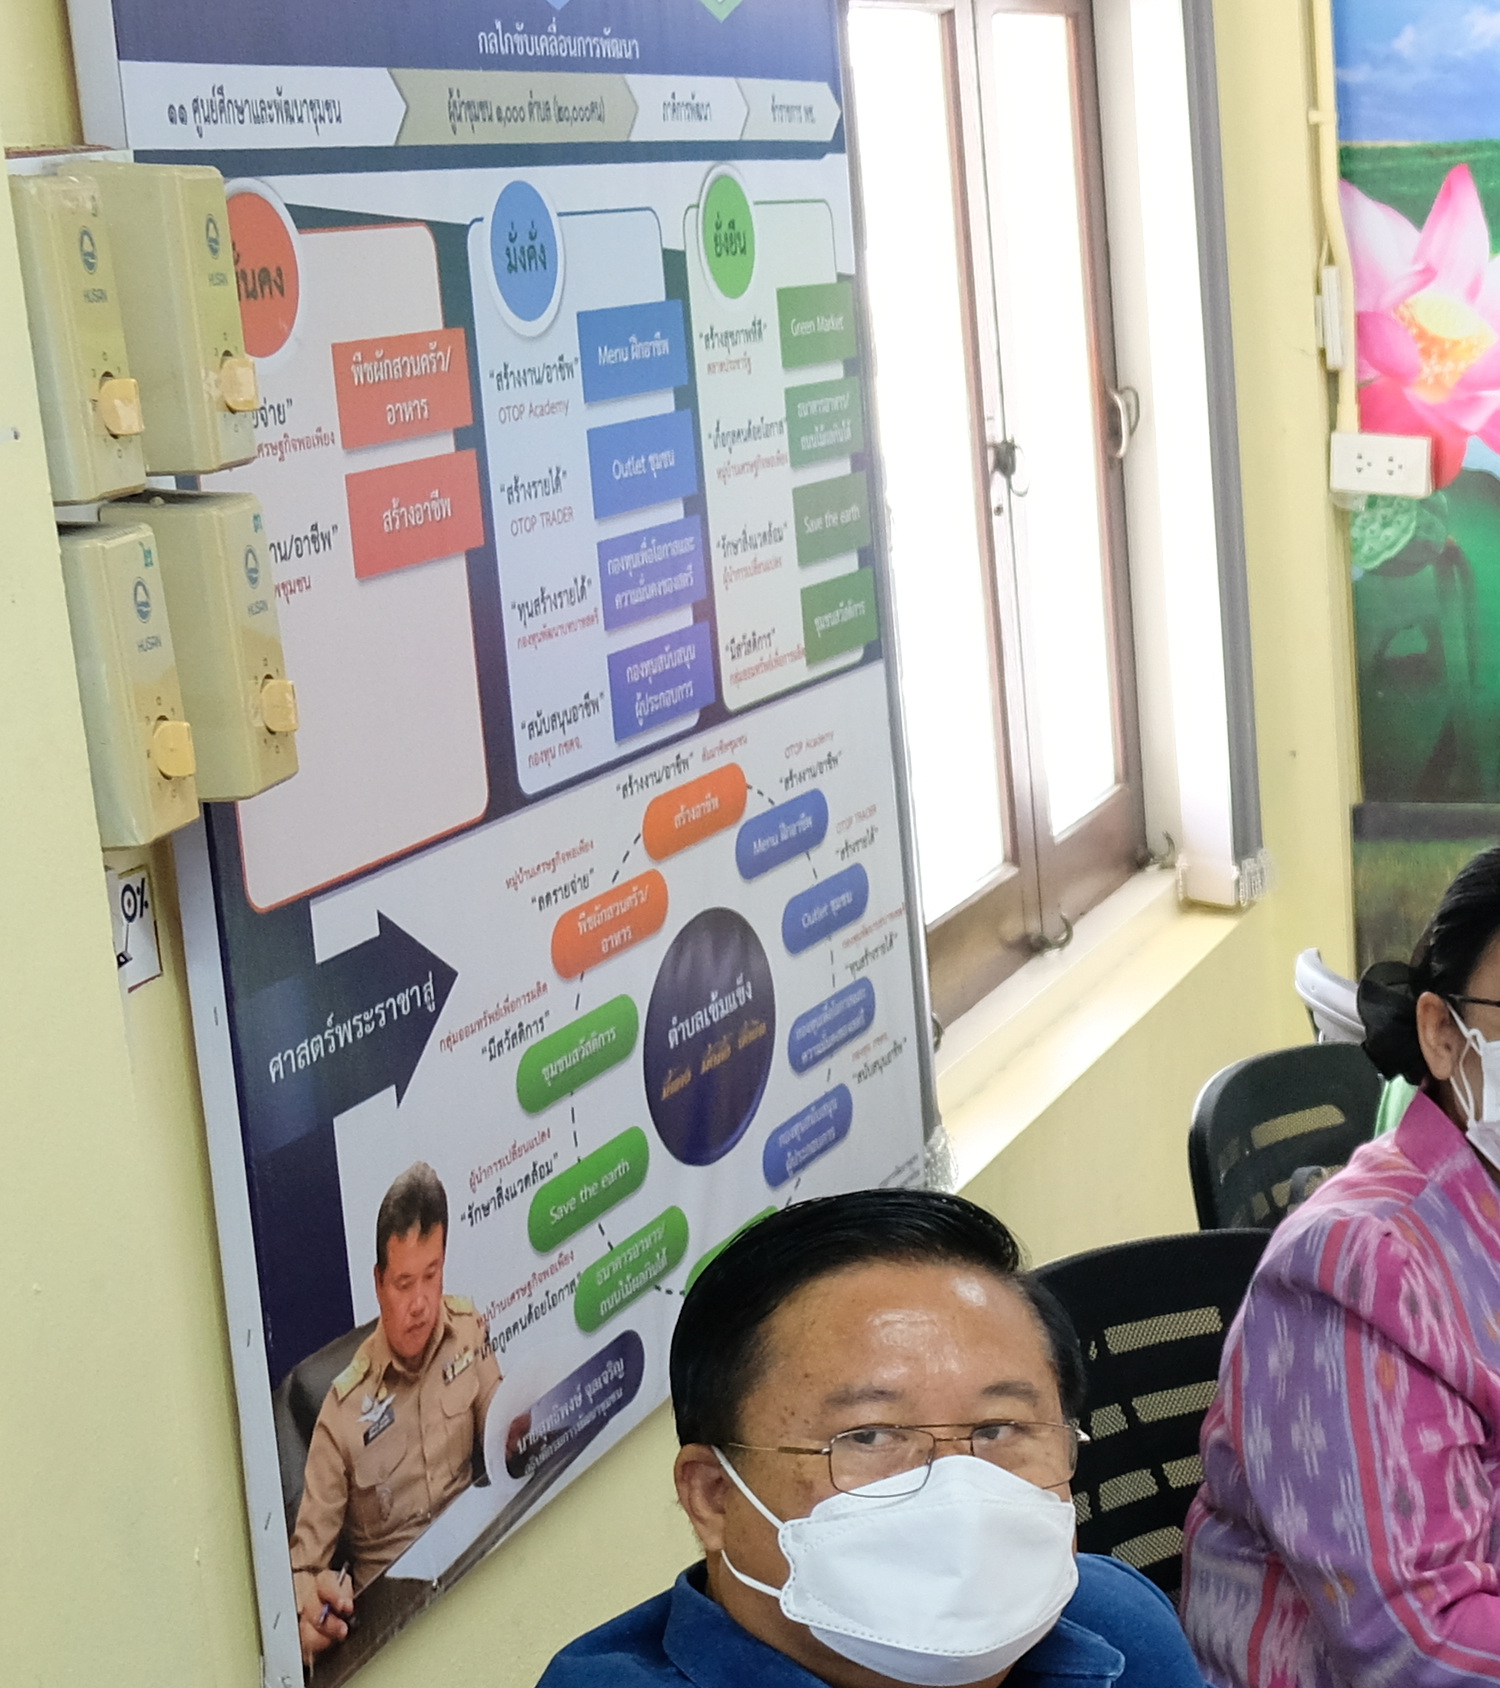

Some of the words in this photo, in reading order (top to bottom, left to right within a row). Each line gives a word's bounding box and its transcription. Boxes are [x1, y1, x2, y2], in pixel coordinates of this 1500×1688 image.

[478, 18, 640, 60] กลไกขับเคลื่อนการพัฒนา
[191, 84, 342, 138] ศูนย์ศึกษาและพัฒนาชุมชน
[506, 221, 547, 275] มั่งคั่ง
[713, 211, 747, 258] ยั่งยืน
[598, 345, 629, 367] Menu
[629, 330, 671, 362] ฝึกอาชีพ
[790, 317, 815, 337] Green
[816, 314, 845, 333] Market
[351, 341, 451, 386] พืชผักสวนครัว/
[489, 353, 580, 393] “สร้างงาน/อาชีพ”
[386, 398, 430, 425] อาหาร
[499, 404, 524, 425] OTOP
[528, 398, 570, 421] Academy
[500, 465, 568, 505] “สร้างรายได้”
[612, 455, 647, 481] Outlet
[648, 449, 676, 479] ชุมชน
[382, 489, 452, 534] สร้างอาชีพ
[510, 515, 537, 538] OTOP
[539, 505, 575, 528] TRADER
[804, 515, 823, 535] Save
[824, 510, 839, 529] the
[839, 504, 862, 523] earth
[511, 574, 593, 629] “ทุนสร้างรายได้”
[626, 643, 697, 684] กองทุนสนับสนุน
[520, 690, 606, 742] “สนับสนุนอาชีพ”
[634, 680, 695, 727] ผู้ประกอบการ
[616, 751, 695, 800] “สร้างงาน/อาชีพ”
[531, 867, 596, 913] “ลดรายจ่าย”
[268, 970, 437, 1084] ศาสตร์พระราชาสู่
[667, 972, 754, 1050] ตำบลเข้มแข็ง
[481, 1009, 551, 1062] “มีสวัสดิการ”
[541, 1026, 617, 1087] ชุมชนสวัสดิการ
[460, 1151, 560, 1229] “รักษาสิ่งแวดล้อม”
[550, 1195, 578, 1226] Save
[579, 1182, 600, 1205] the
[600, 1158, 632, 1190] earth
